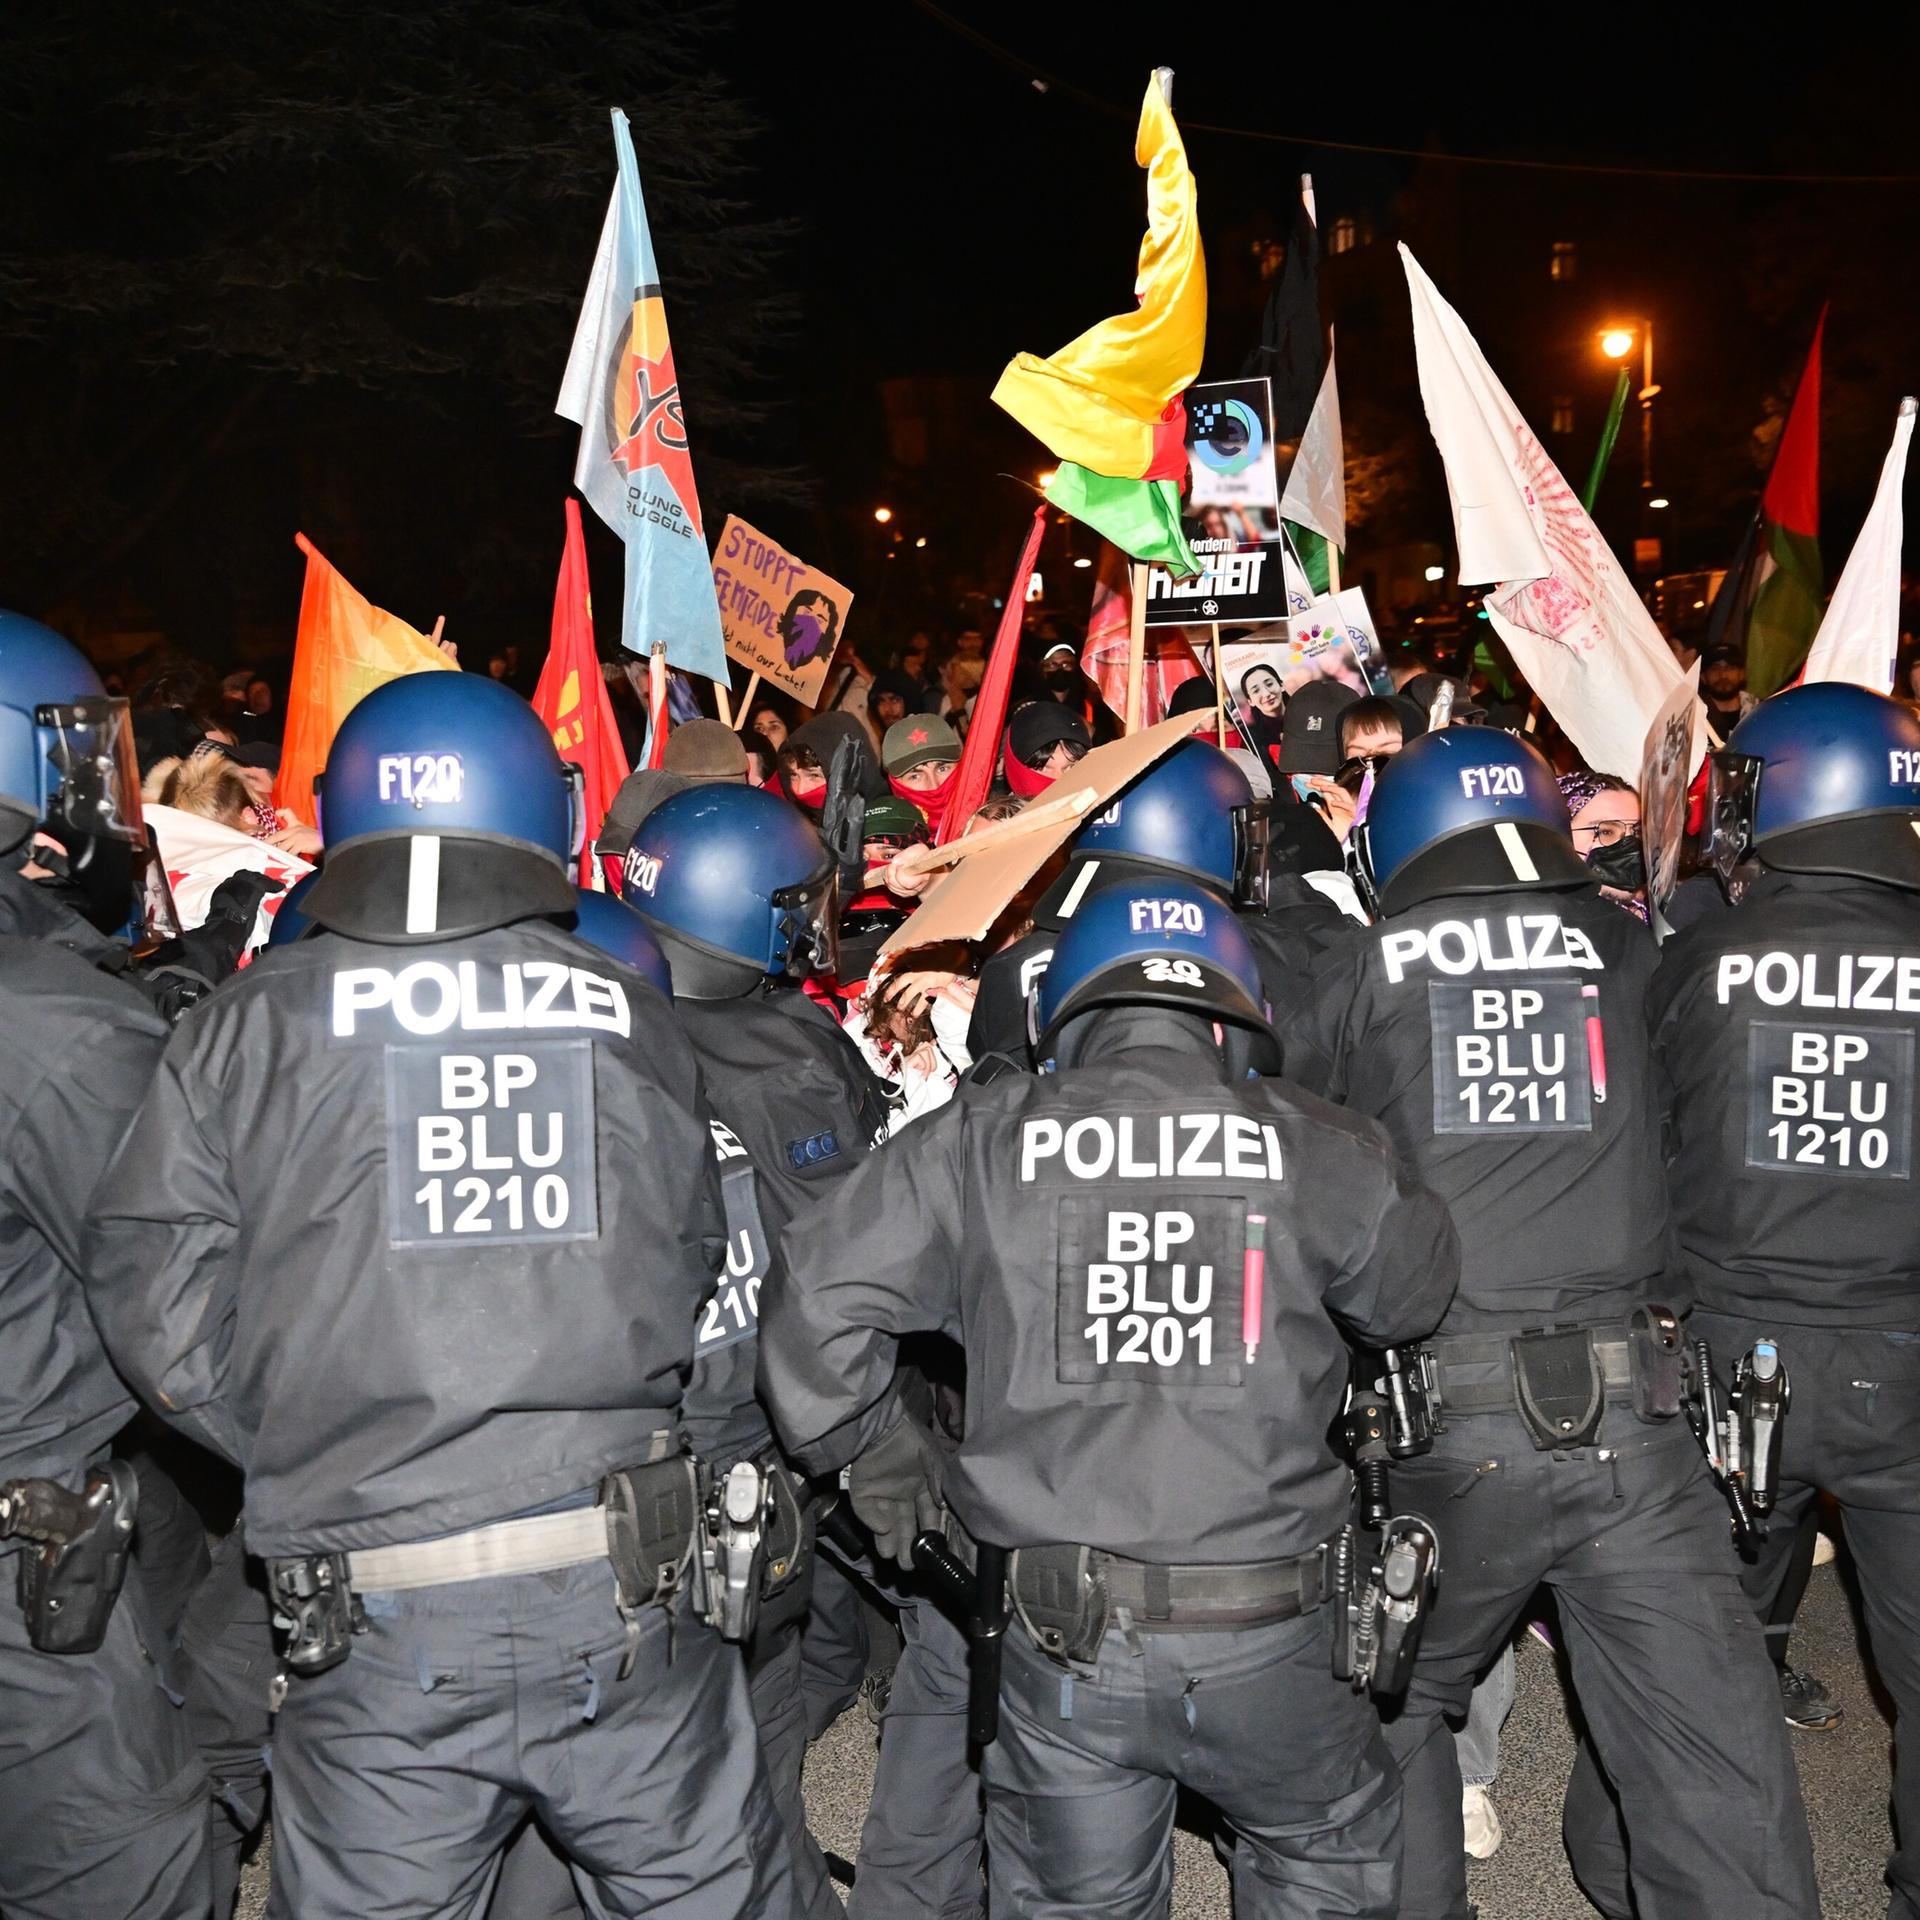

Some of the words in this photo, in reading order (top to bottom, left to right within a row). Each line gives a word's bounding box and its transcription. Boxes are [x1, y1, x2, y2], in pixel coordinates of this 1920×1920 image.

[626, 500, 694, 539] RUGGLE
[627, 486, 683, 518] OUNG
[725, 525, 807, 596] STOPPT
[1189, 537, 1232, 553] fordern
[379, 755, 461, 802] F120
[1461, 765, 1524, 798] F120
[1889, 751, 1920, 783] F12
[624, 847, 659, 892] F120
[1131, 901, 1203, 932] F120
[332, 961, 631, 1038] POLIZEI
[1717, 952, 1920, 1013] POLIZE
[1473, 989, 1544, 1030] BP
[1457, 1033, 1565, 1077] BLU
[1791, 1032, 1869, 1076] BP
[440, 1054, 538, 1109] BP
[1459, 1081, 1566, 1123] 1211
[1772, 1077, 1887, 1122] BLU
[418, 1112, 563, 1172] BLU
[1021, 1114, 1283, 1182] POLIZEI
[1768, 1121, 1889, 1169] 1210
[415, 1175, 570, 1234] 1210
[1107, 1211, 1195, 1262] BP
[699, 1276, 762, 1343] 210
[1087, 1264, 1213, 1314] BLU
[1084, 1314, 1213, 1367] 1201
